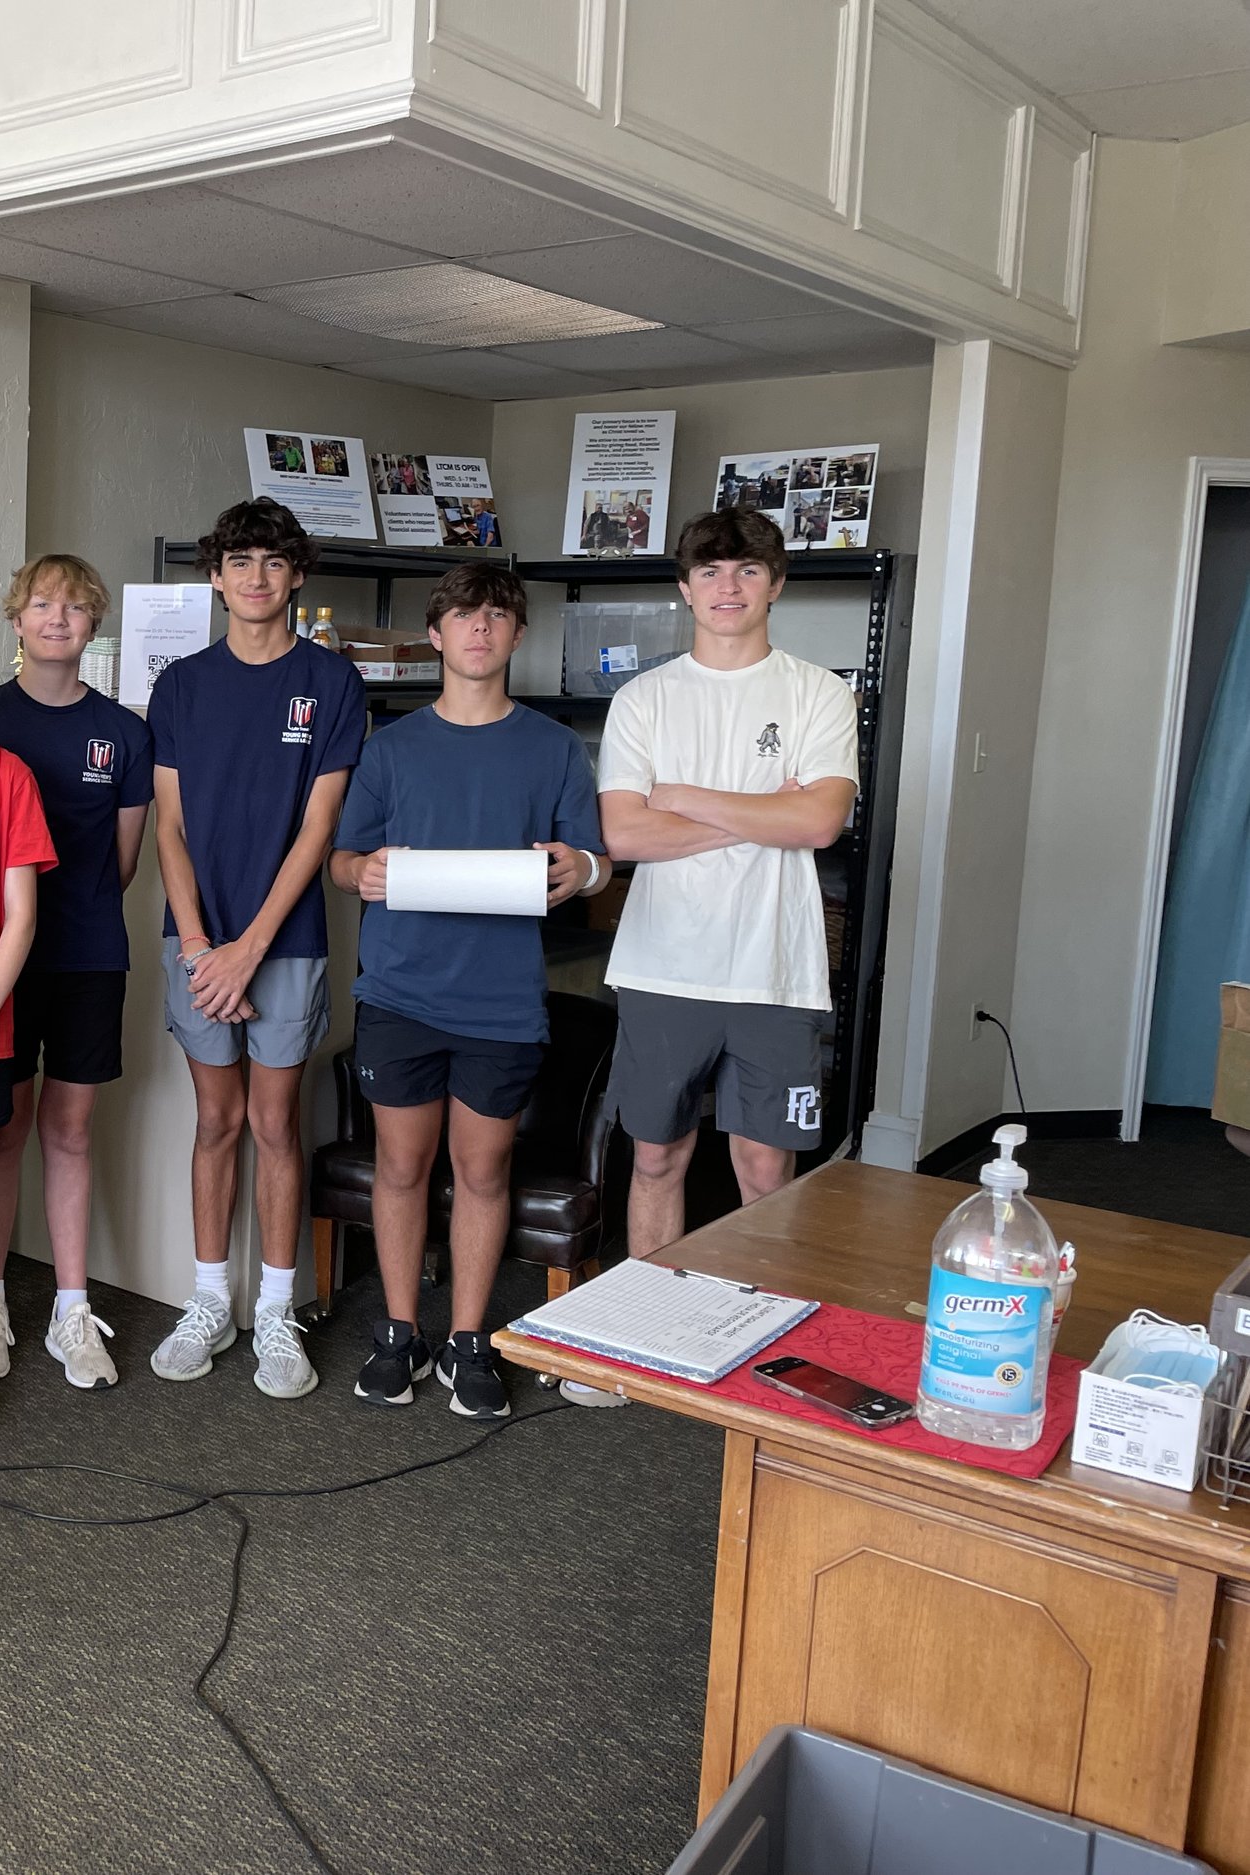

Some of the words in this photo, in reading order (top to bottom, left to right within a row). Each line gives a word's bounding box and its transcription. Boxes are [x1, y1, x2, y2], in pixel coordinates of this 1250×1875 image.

[436, 463, 453, 471] LTCM
[462, 464, 481, 472] OPEN
[945, 1295, 1026, 1317] germ-X
[939, 1330, 1000, 1353] moisturizing
[938, 1343, 982, 1360] original
